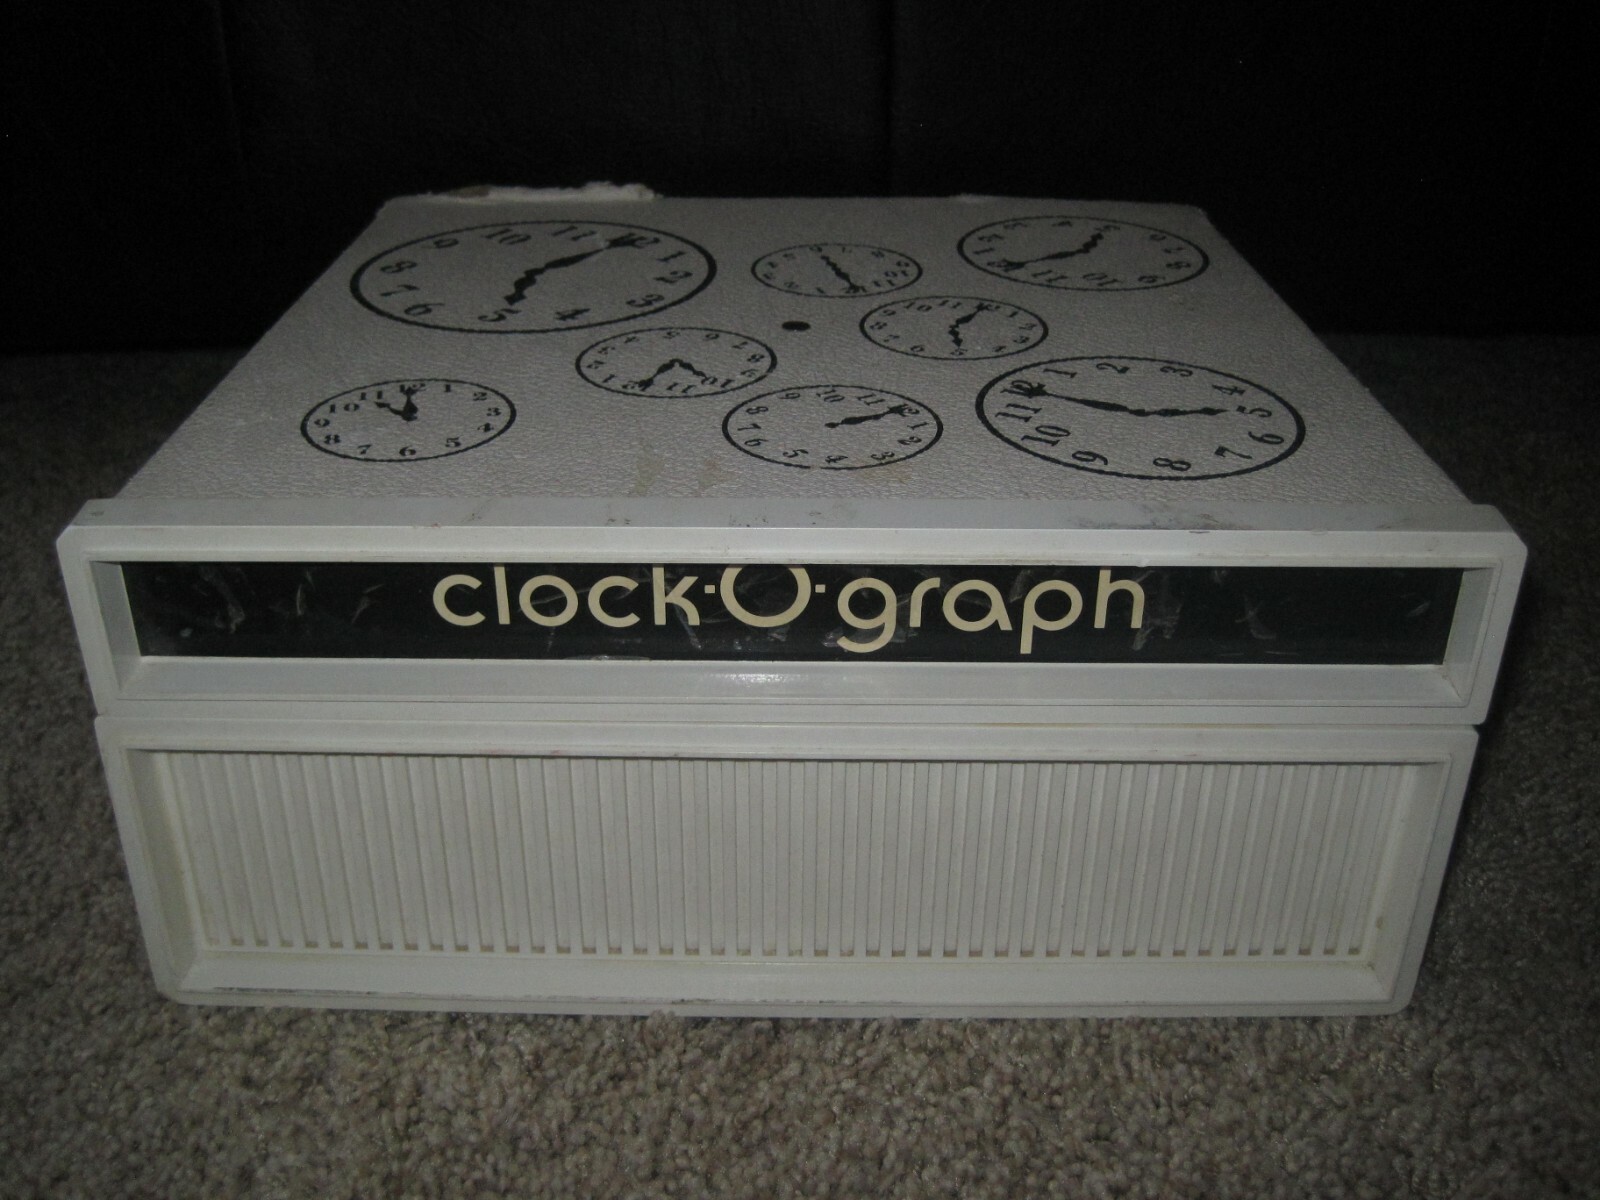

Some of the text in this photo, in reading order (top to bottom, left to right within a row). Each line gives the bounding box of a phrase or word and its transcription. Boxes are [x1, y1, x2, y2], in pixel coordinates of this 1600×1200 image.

[656, 250, 686, 263] 1
[380, 261, 417, 274] 8
[654, 270, 693, 284] 2
[380, 284, 419, 297] 7
[625, 294, 665, 307] 3
[403, 303, 445, 316] 6
[478, 308, 522, 322] 5
[554, 308, 591, 321] 4
[1043, 368, 1078, 378] 1
[1096, 363, 1130, 373] 2
[1160, 366, 1193, 377] 3
[444, 384, 452, 393] 1
[1212, 384, 1246, 396] 4
[359, 391, 383, 400] 11
[473, 392, 487, 401] 2
[816, 389, 845, 402] 10
[856, 393, 886, 406] 11
[330, 403, 360, 413] 10
[487, 408, 501, 416] 3
[746, 406, 769, 414] 8
[995, 403, 1043, 423] 11
[1236, 406, 1273, 417] 5
[477, 422, 494, 432] 4
[907, 422, 930, 430] 1
[324, 434, 341, 444] 8
[897, 436, 922, 445] 2
[1021, 425, 1071, 446] 10
[1248, 431, 1285, 444] 6
[445, 437, 461, 447] 5
[357, 444, 371, 455] 7
[399, 446, 417, 456] 6
[783, 449, 809, 458] 5
[1214, 446, 1253, 459] 7
[825, 455, 848, 464] 4
[871, 451, 895, 460] 3
[1072, 451, 1109, 465] 9
[1153, 457, 1192, 471] 8
